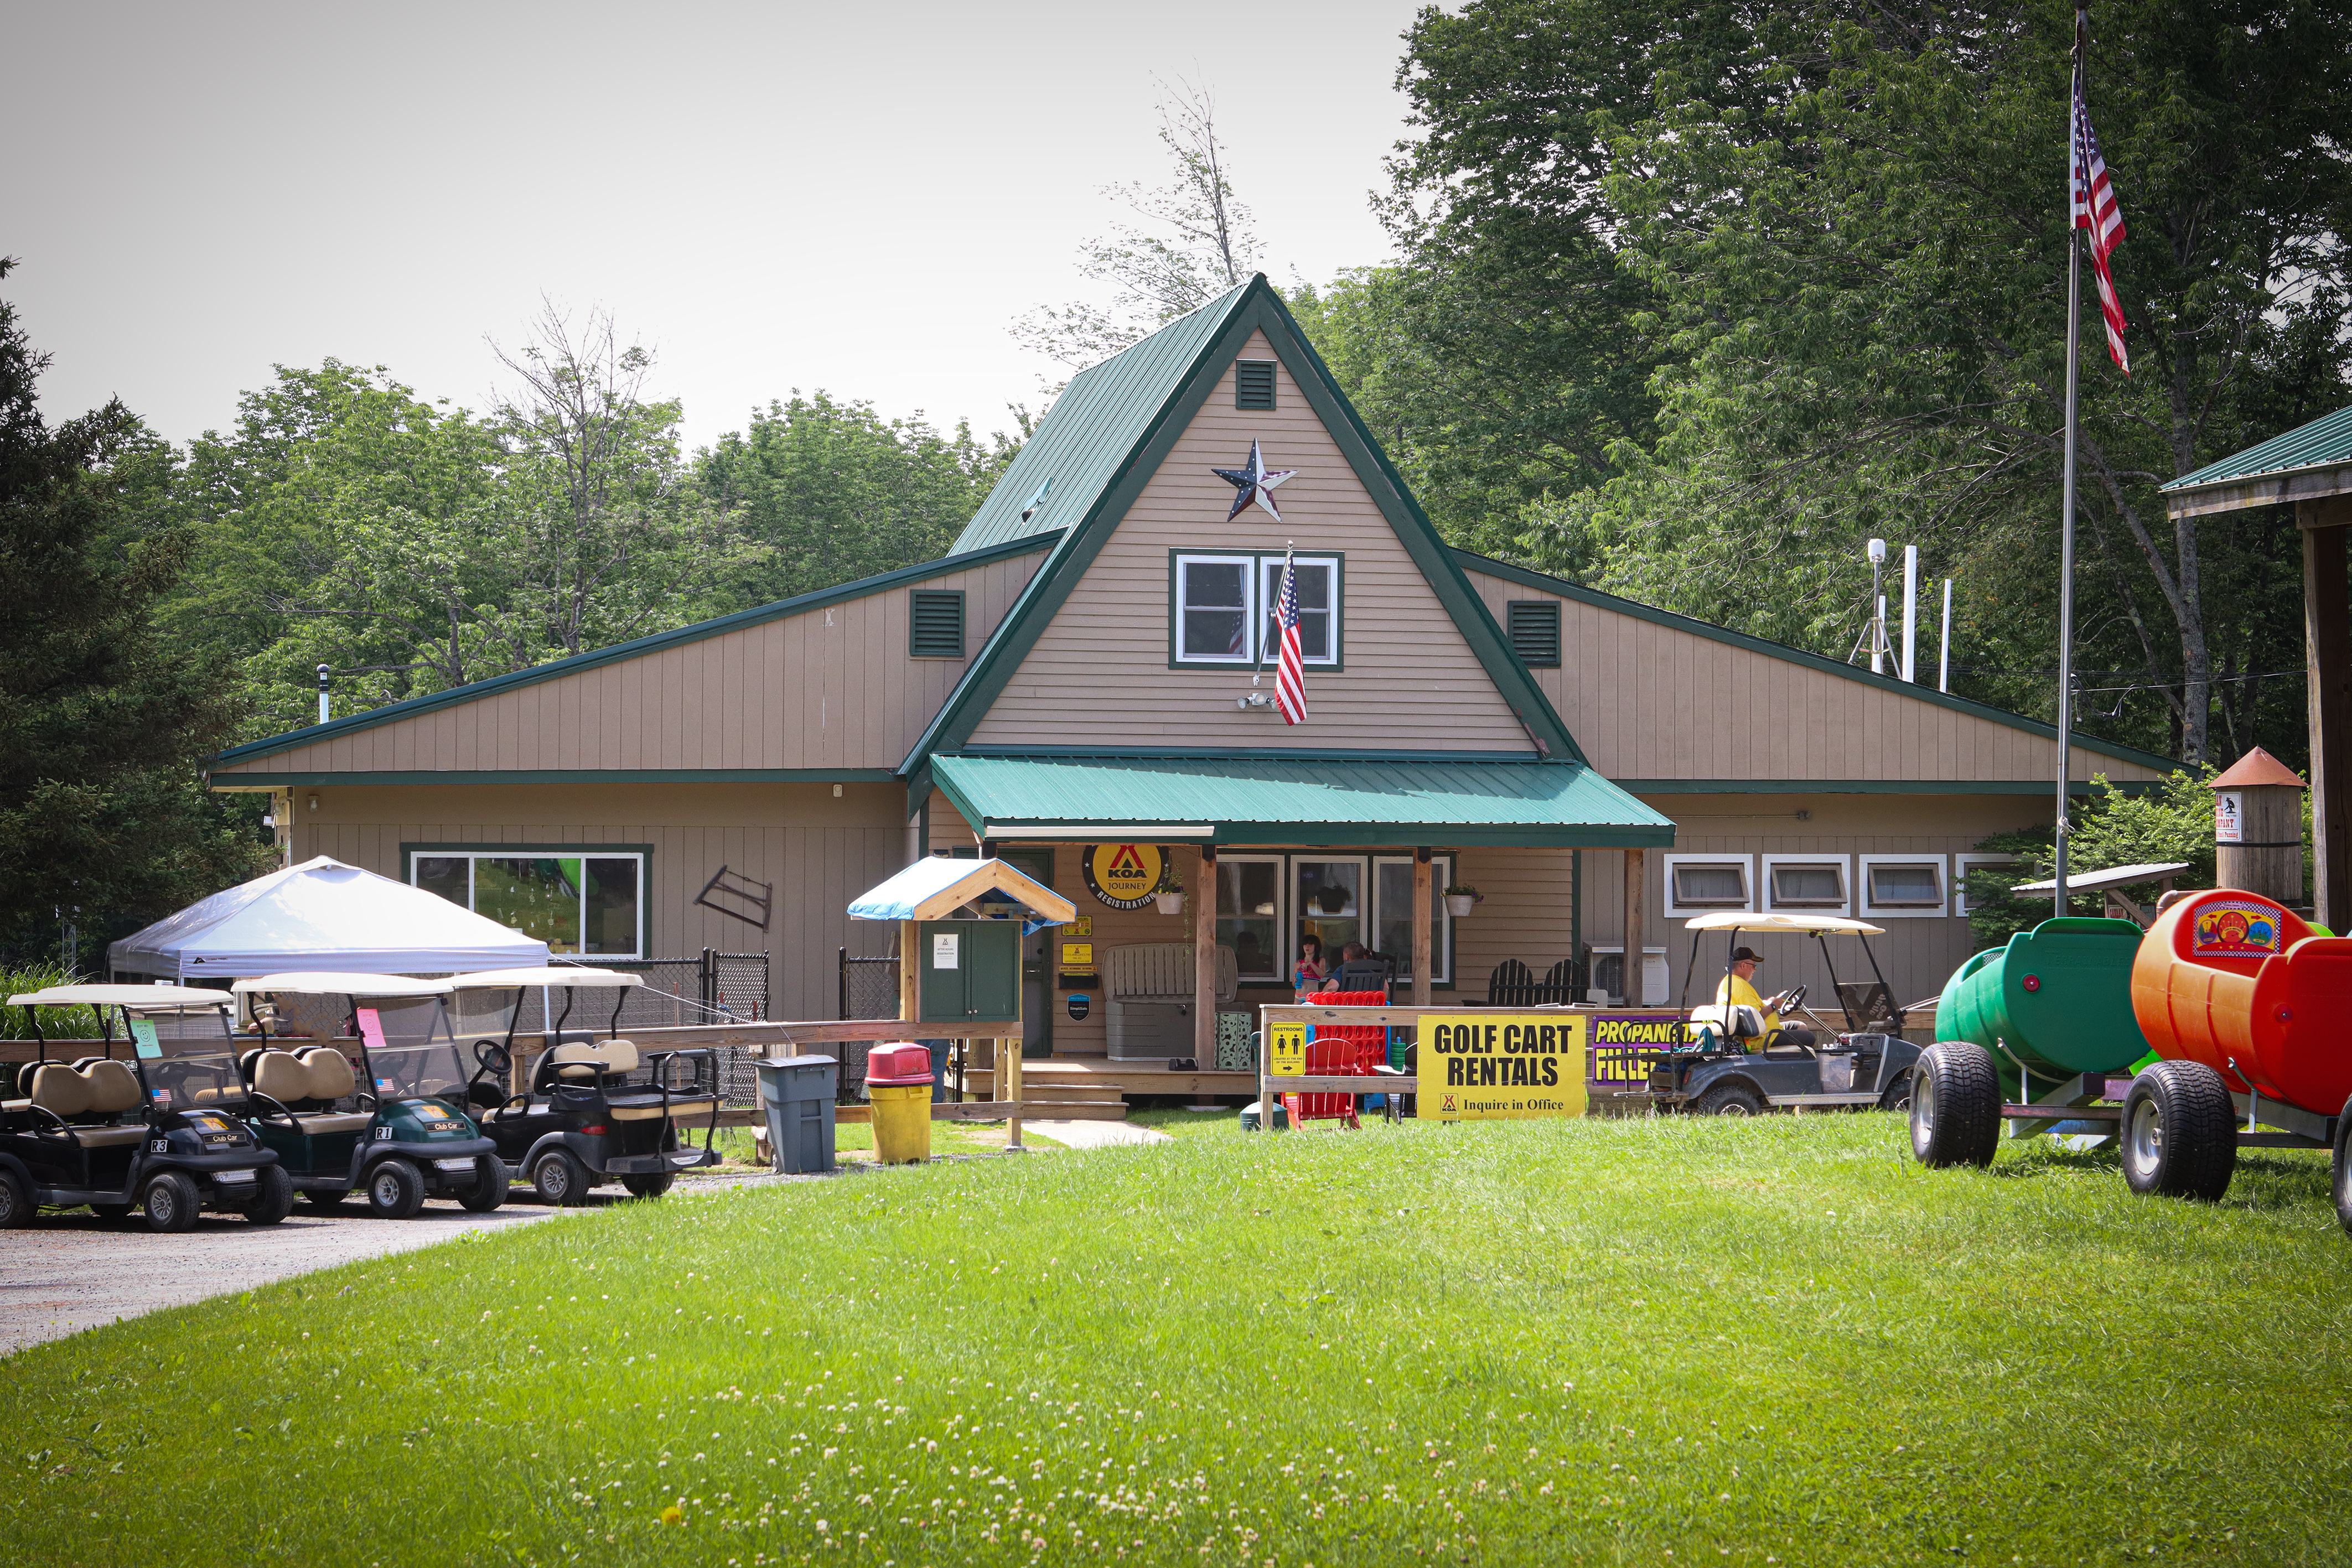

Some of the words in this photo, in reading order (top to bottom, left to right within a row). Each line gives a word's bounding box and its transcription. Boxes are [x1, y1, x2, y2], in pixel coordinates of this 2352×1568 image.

[1108, 869, 1147, 878] KOA
[1096, 891, 1157, 910] REGISTRATION
[1434, 1024, 1497, 1054] GOLF
[1504, 1024, 1572, 1054] CART
[1447, 1057, 1558, 1087] RENTALS
[1464, 1099, 1509, 1113] Inquire
[1512, 1099, 1524, 1110] in
[1527, 1098, 1564, 1110] Office
